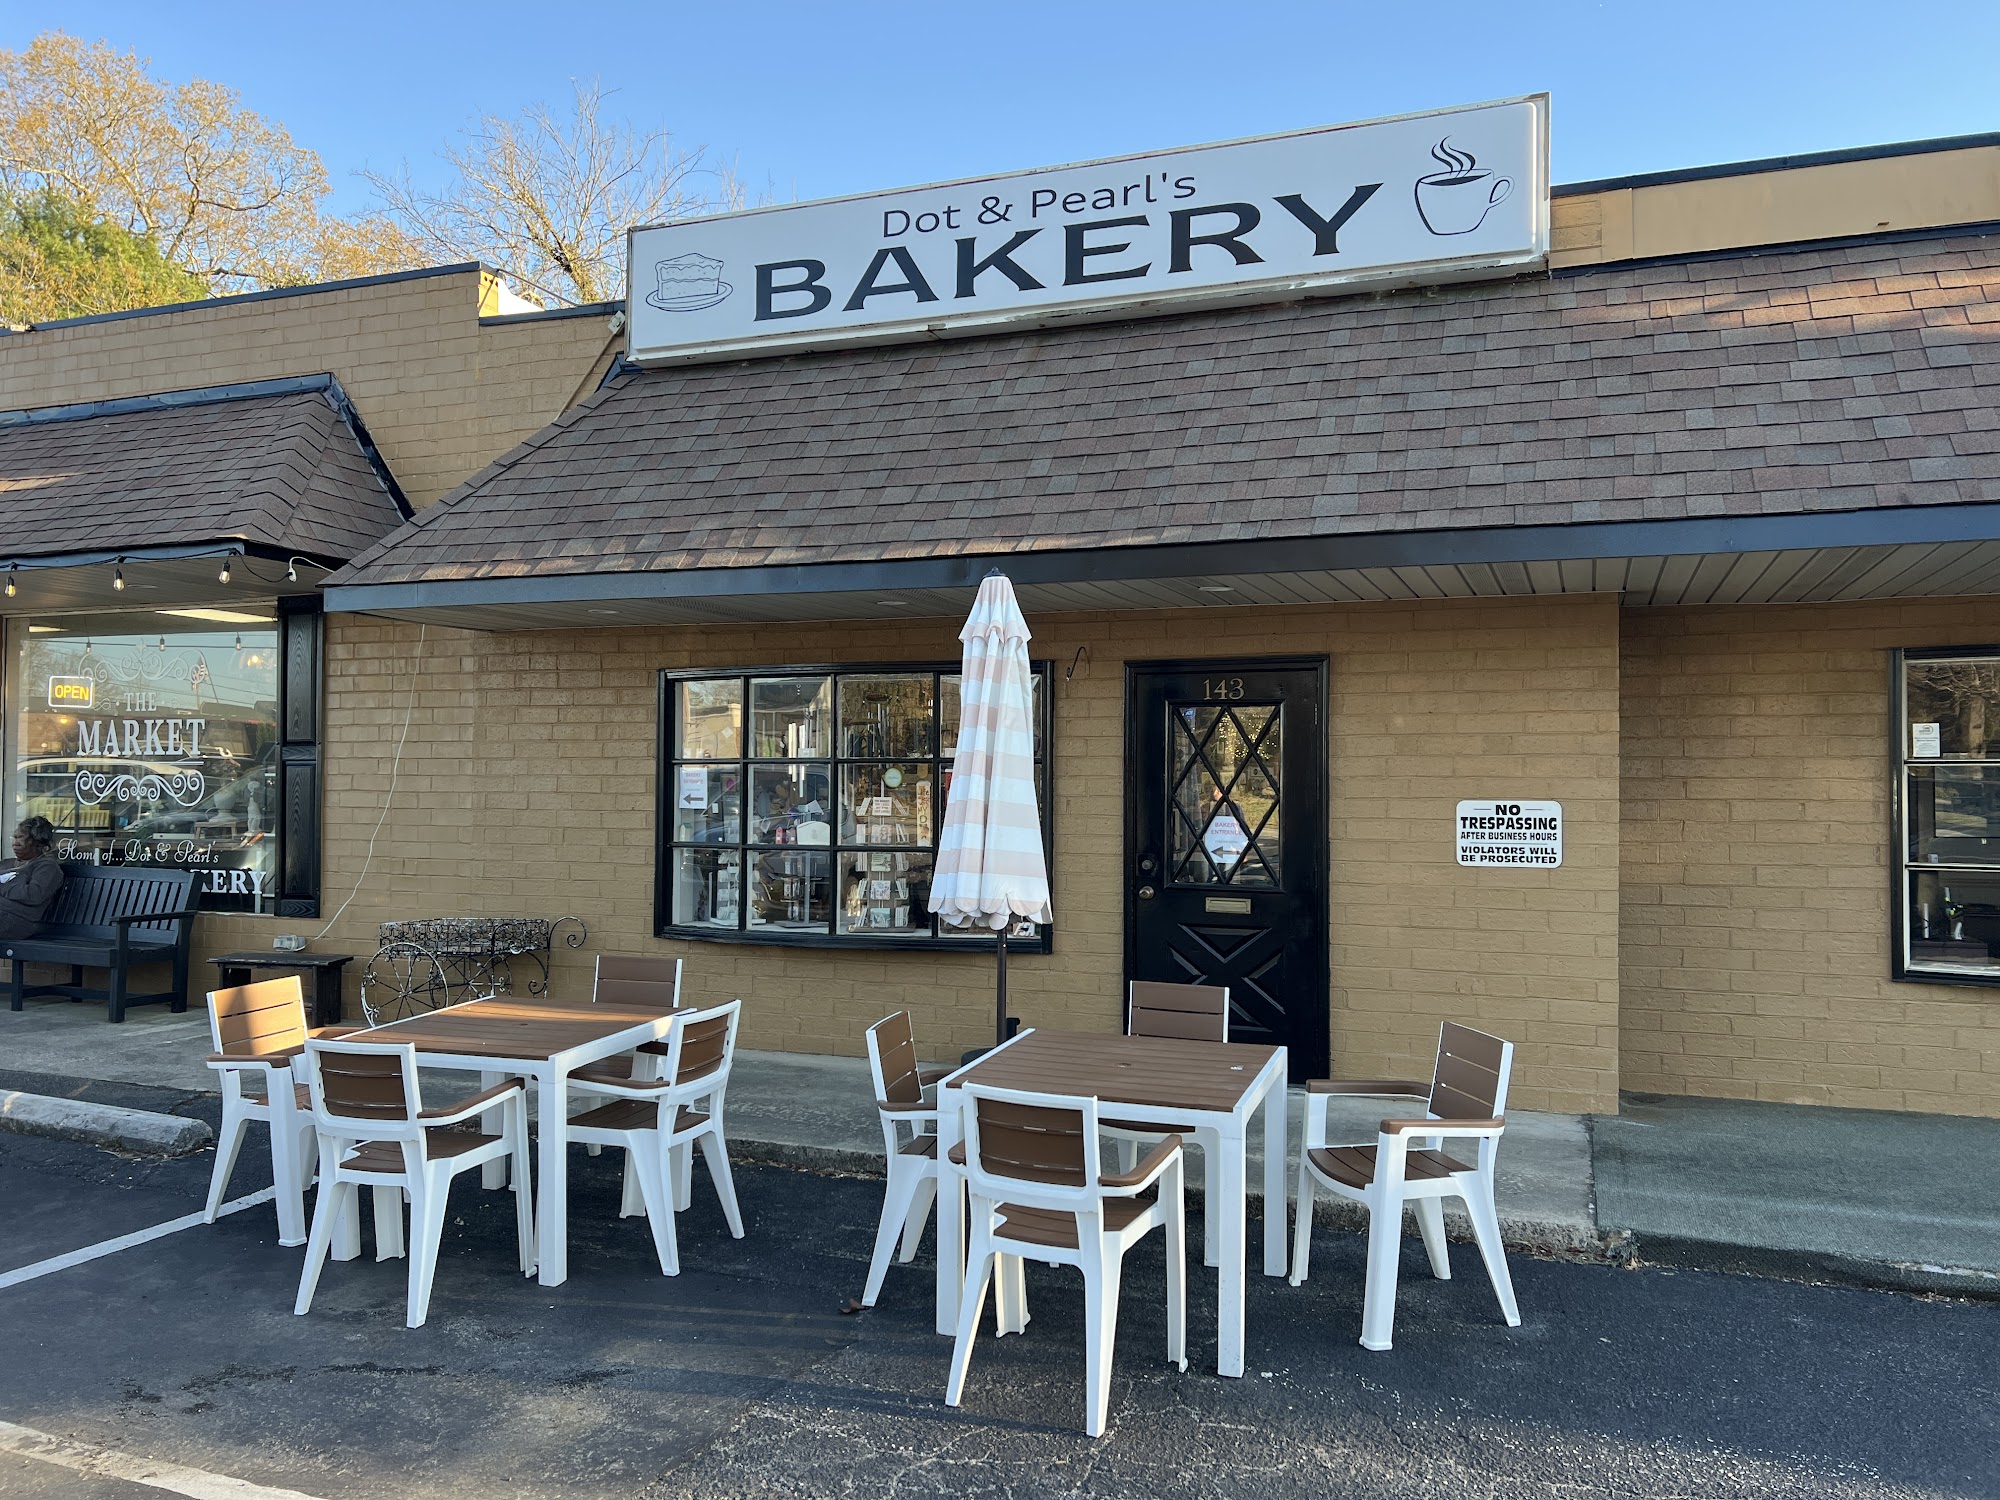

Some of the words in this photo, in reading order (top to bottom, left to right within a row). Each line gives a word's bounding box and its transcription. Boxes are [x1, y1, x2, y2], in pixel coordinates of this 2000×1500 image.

[882, 203, 961, 238] Dot
[977, 196, 1012, 225] &
[1031, 172, 1197, 219] Pearl's
[753, 182, 1384, 322] BAKERY
[54, 684, 90, 701] OPEN
[1203, 678, 1245, 700] 143
[123, 692, 157, 712] THE
[76, 718, 206, 757] MARKET
[1495, 804, 1521, 816] NO
[1460, 817, 1557, 830] TRESPASSING
[1460, 831, 1486, 840] AFTER
[1488, 832, 1527, 841] BUSINESS
[1530, 832, 1557, 841] HOURS
[155, 842, 171, 862] &
[174, 839, 219, 863] Pearl's
[1461, 846, 1526, 855] VIOLATORS
[1529, 847, 1557, 855] WILL
[1461, 854, 1476, 862] BE
[1480, 855, 1557, 863] PROSECUTED
